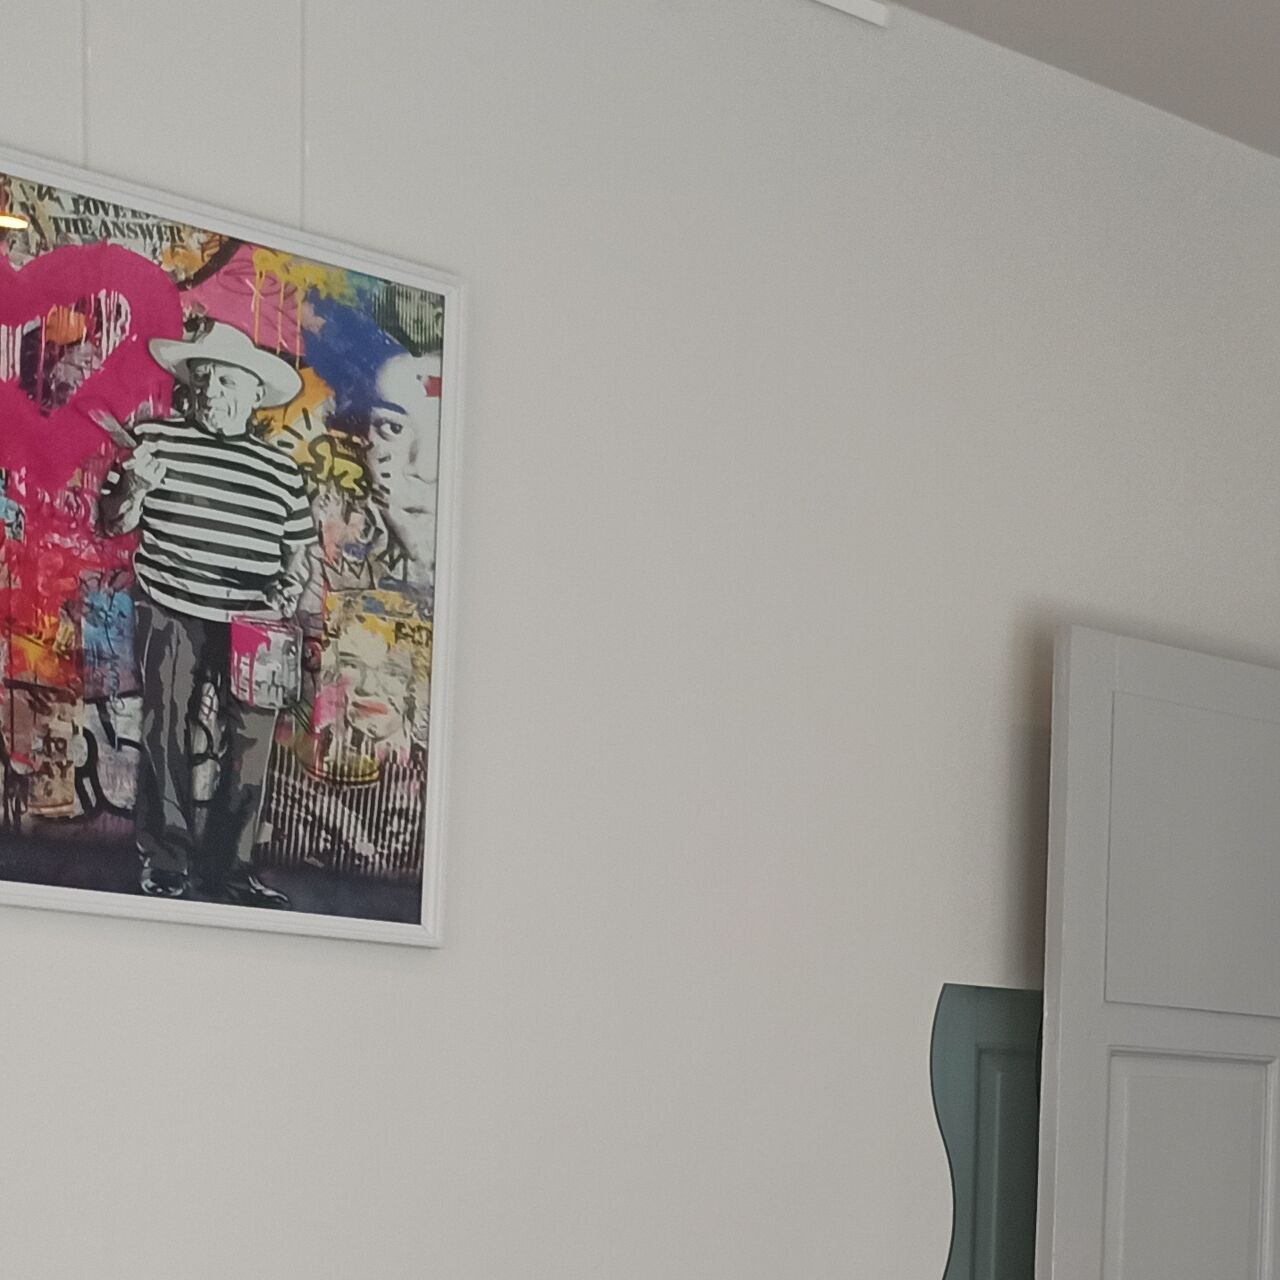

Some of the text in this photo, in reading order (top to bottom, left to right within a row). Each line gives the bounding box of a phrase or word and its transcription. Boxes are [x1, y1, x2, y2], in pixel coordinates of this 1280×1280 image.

[72, 193, 127, 220] LOVE
[51, 215, 185, 243] THE ANSWER
